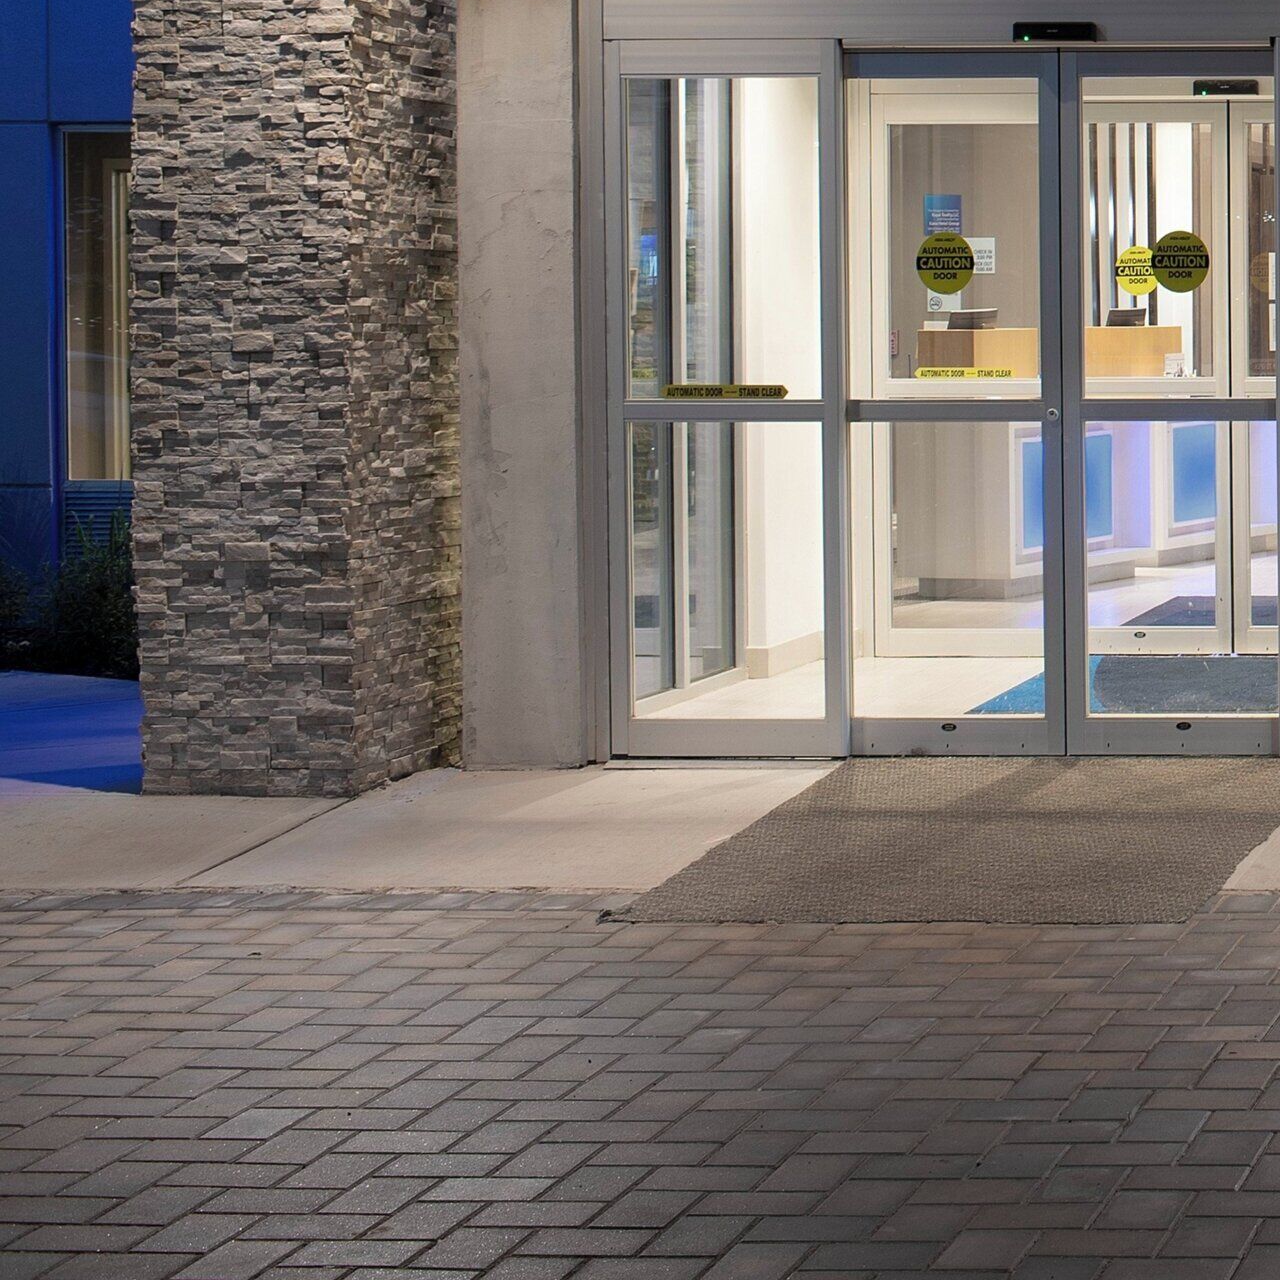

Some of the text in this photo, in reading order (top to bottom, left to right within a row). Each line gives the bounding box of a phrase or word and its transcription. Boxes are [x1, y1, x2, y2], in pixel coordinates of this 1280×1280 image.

[1157, 245, 1203, 253] AUTOMATIC
[920, 257, 971, 269] CAUTION
[1155, 256, 1206, 267] CAUTION
[933, 272, 958, 280] DOOR
[667, 388, 783, 396] AUTOMATIC DOOR STAND CLEAR
